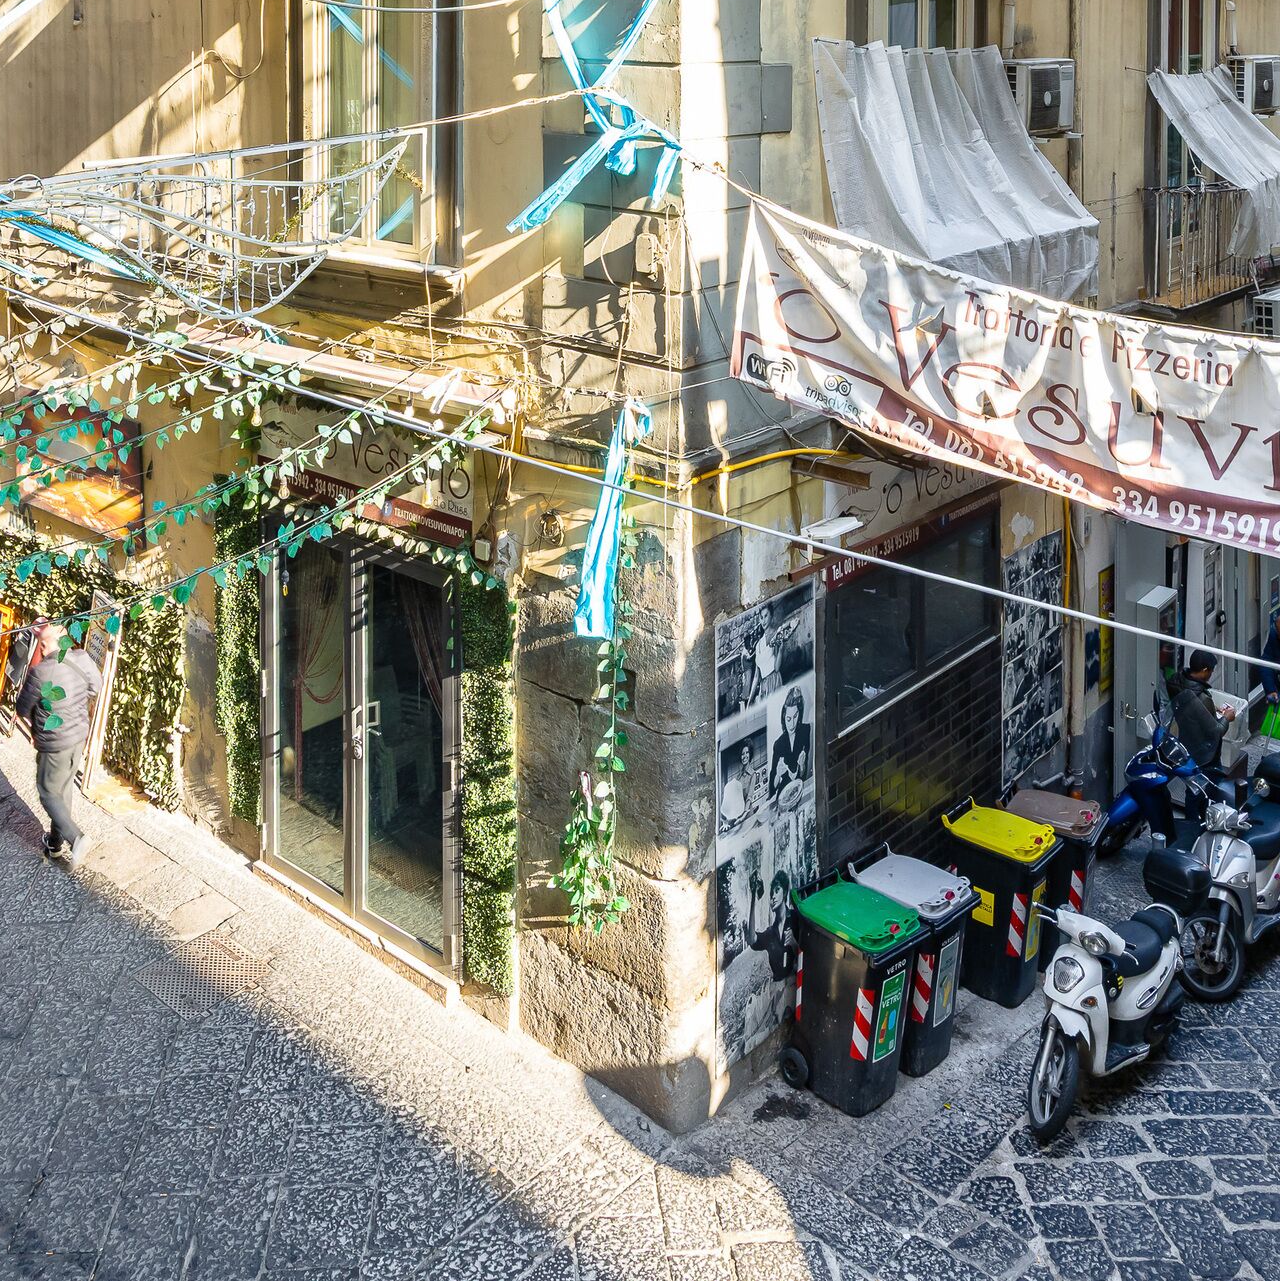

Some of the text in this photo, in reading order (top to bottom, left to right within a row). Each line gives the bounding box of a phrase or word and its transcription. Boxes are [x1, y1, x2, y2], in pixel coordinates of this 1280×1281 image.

[964, 290, 1073, 349] Trattoria
[1111, 329, 1234, 387] Pizzeria
[805, 385, 866, 418] tripadvisor
[1111, 486, 1160, 521] 334
[394, 506, 468, 540] TRATTORIAOVESUVIONAPOL
[883, 539, 894, 556] 334
[886, 958, 907, 975] VETRO
[881, 991, 902, 1009] VETRO
